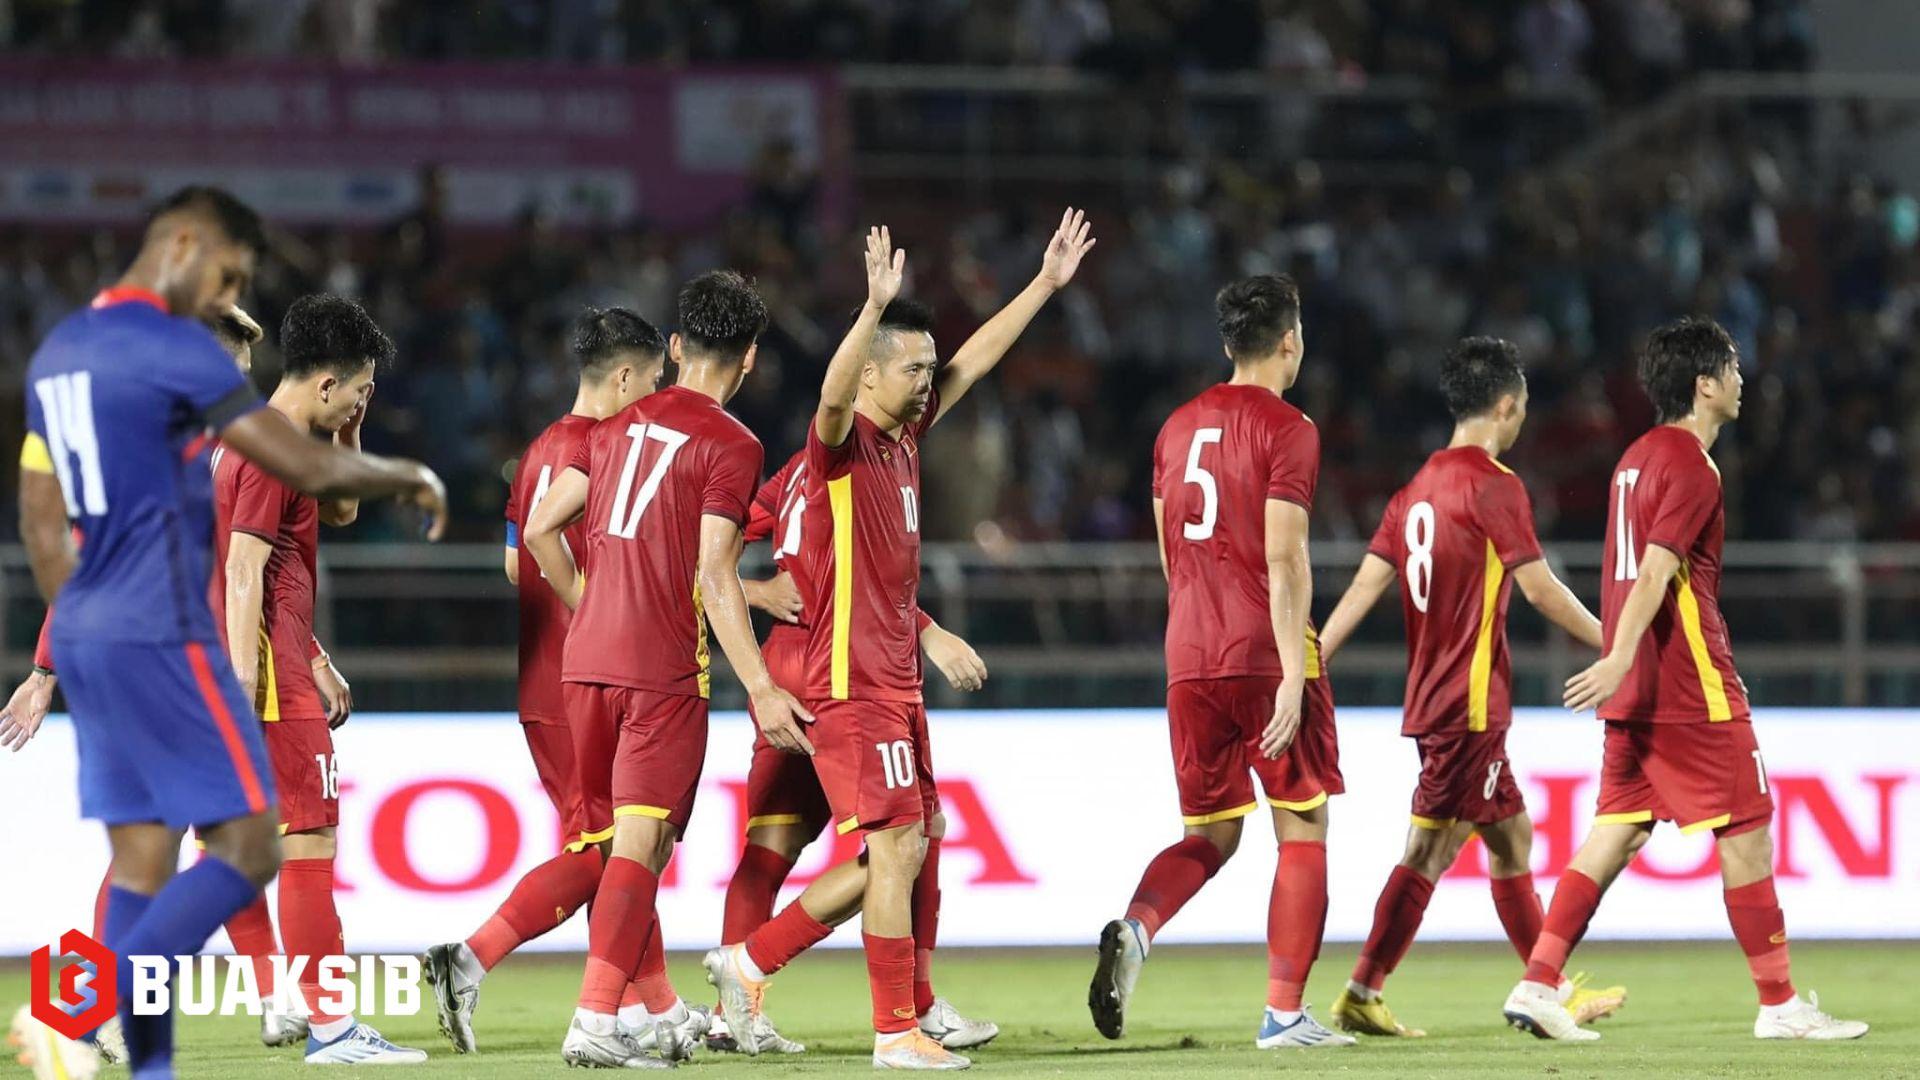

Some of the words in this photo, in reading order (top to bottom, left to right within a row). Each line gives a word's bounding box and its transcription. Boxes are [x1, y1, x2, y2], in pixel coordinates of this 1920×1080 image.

[607, 423, 690, 539] 17
[1184, 428, 1221, 540] 5
[900, 485, 918, 533] 10
[1405, 501, 1435, 613] 8
[315, 752, 338, 800] 16
[877, 740, 914, 790] 10
[1483, 760, 1502, 801] 8
